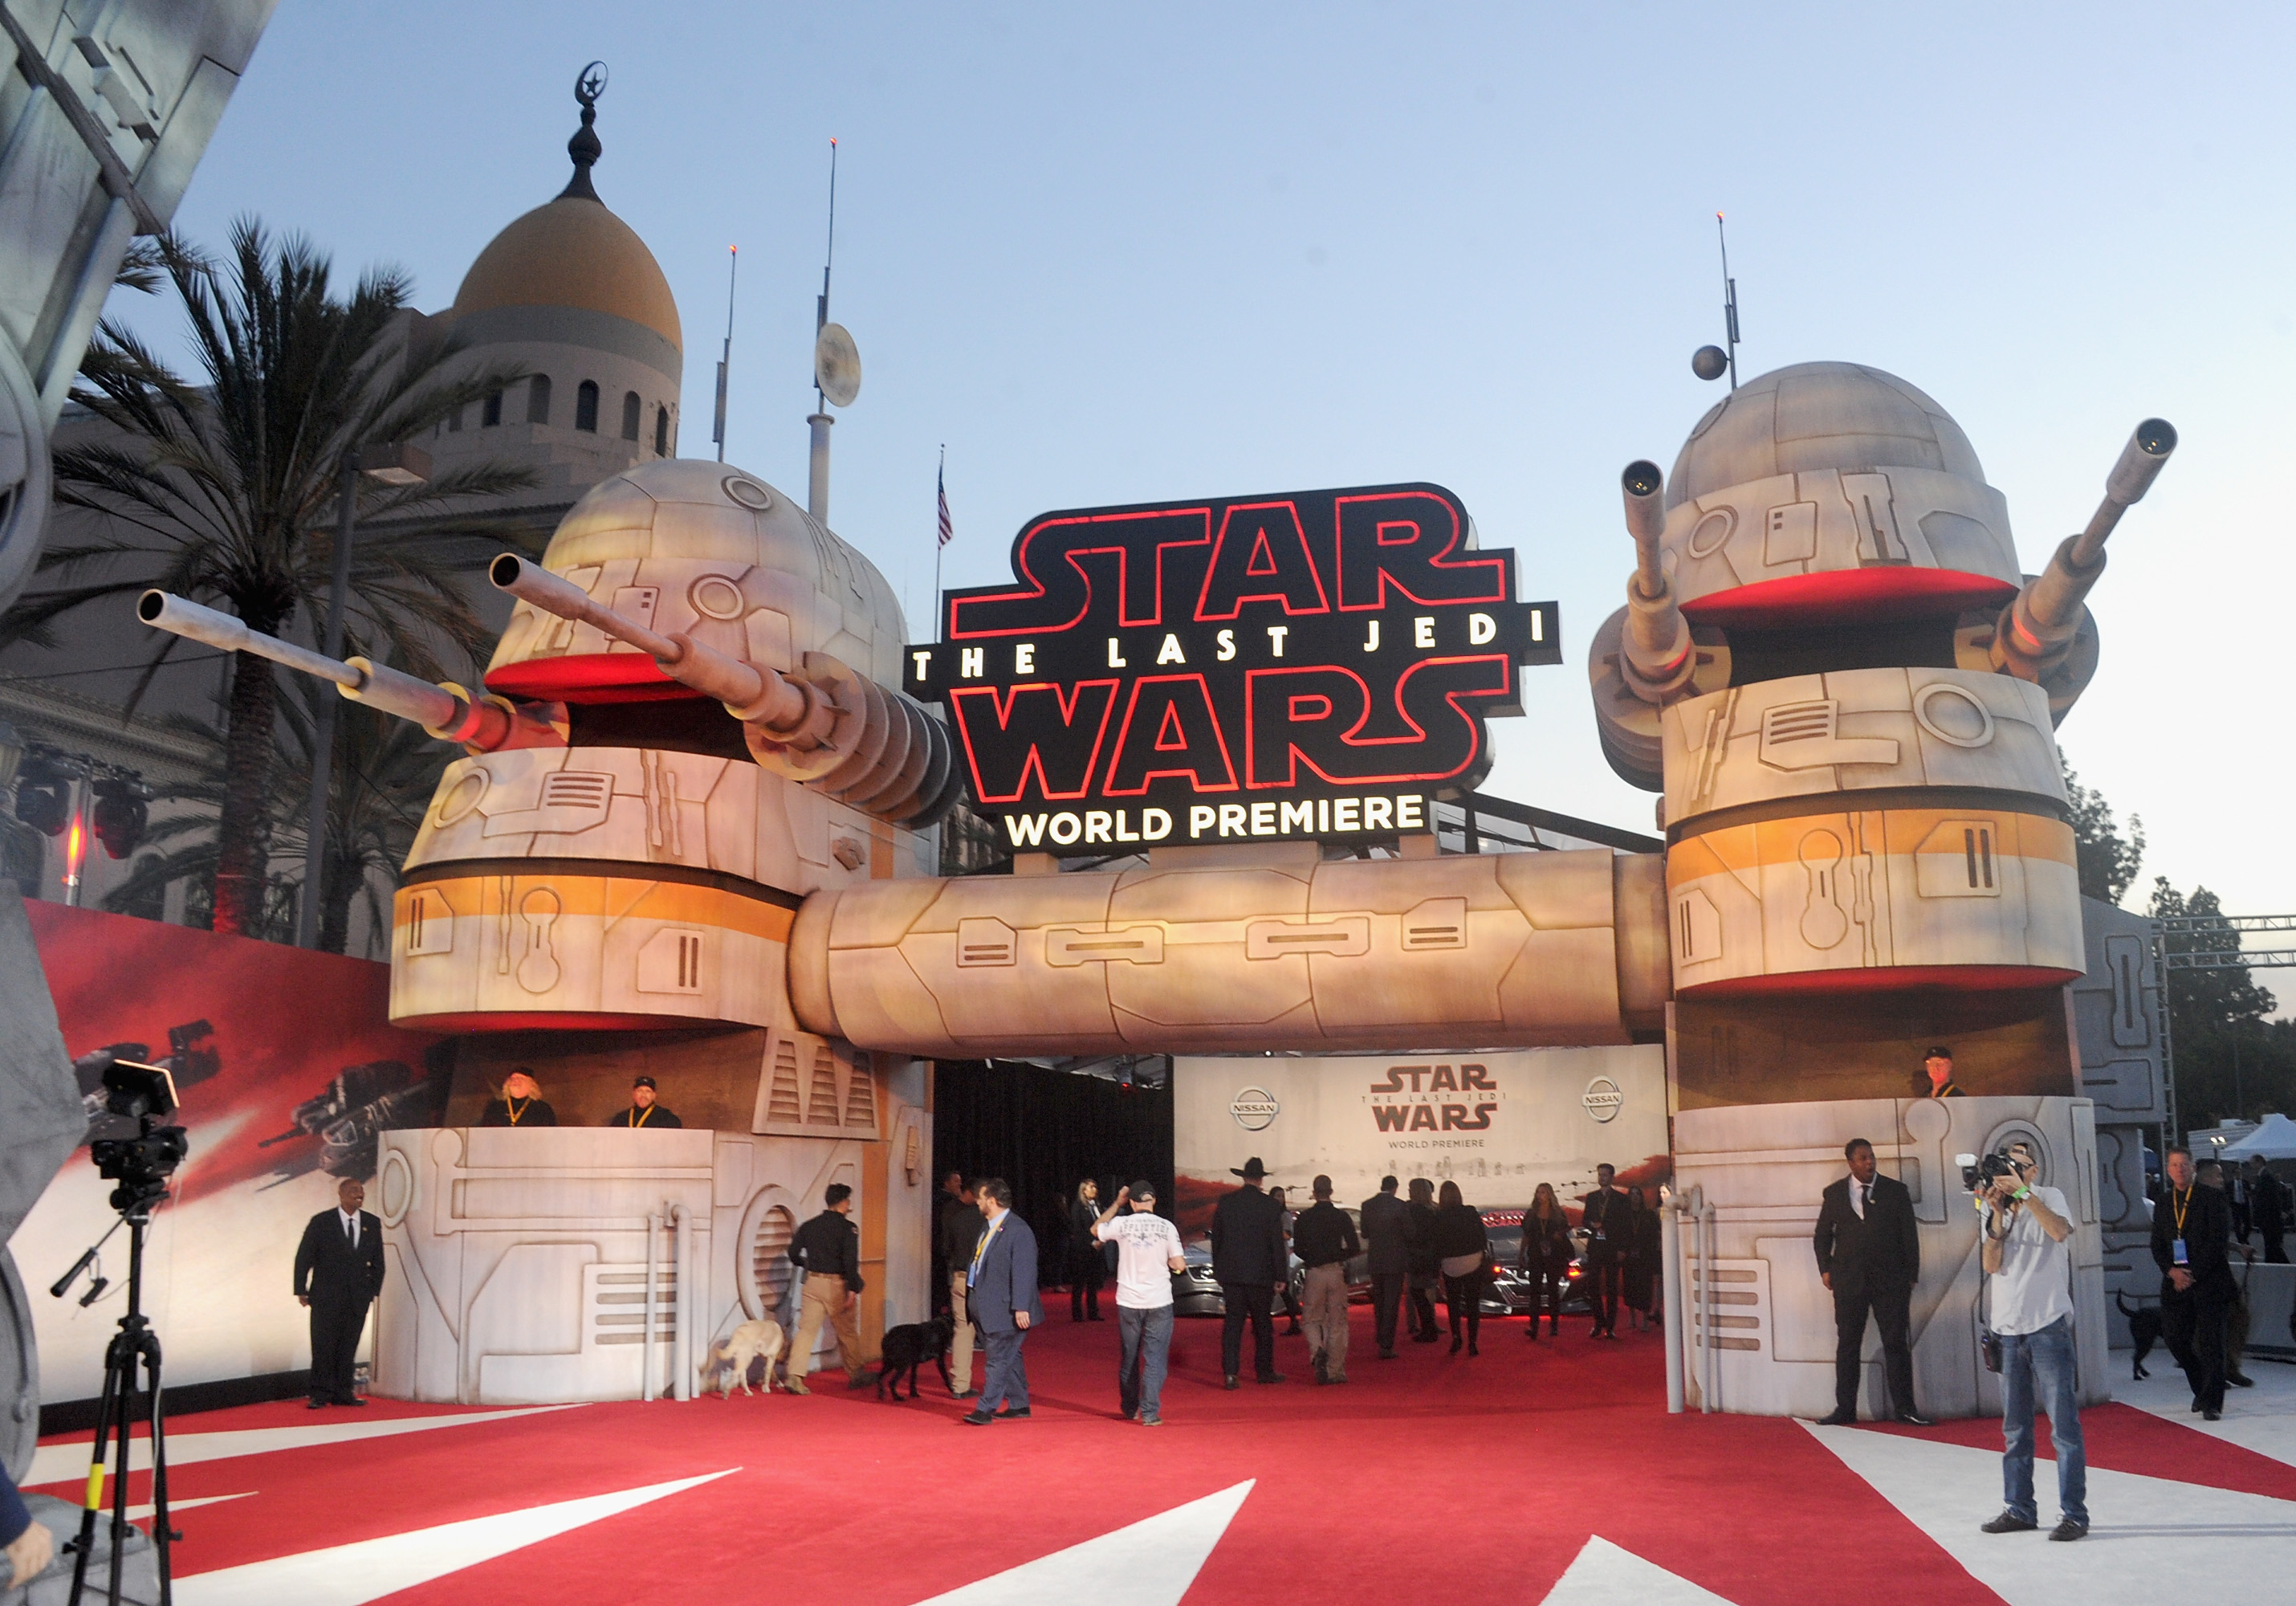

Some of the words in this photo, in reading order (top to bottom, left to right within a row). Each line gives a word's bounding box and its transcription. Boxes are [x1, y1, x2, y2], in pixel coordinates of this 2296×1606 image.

[950, 491, 1506, 639] STAR
[912, 643, 1036, 681] THE
[1108, 626, 1289, 668] LAST
[1363, 609, 1543, 652] JEDI
[950, 654, 1508, 803] WARS
[1004, 809, 1172, 846] WORLD
[1190, 794, 1424, 838] PREMIERE
[1370, 1063, 1497, 1093] STAR
[1362, 1095, 1392, 1103] THE
[1409, 1094, 1451, 1103] LAST
[1468, 1092, 1507, 1102] JEDI
[1586, 1094, 1619, 1103] NISSAN
[1371, 1103, 1497, 1132] WARS
[1388, 1140, 1429, 1149] WORLD
[1432, 1139, 1484, 1148] PREMIERE
